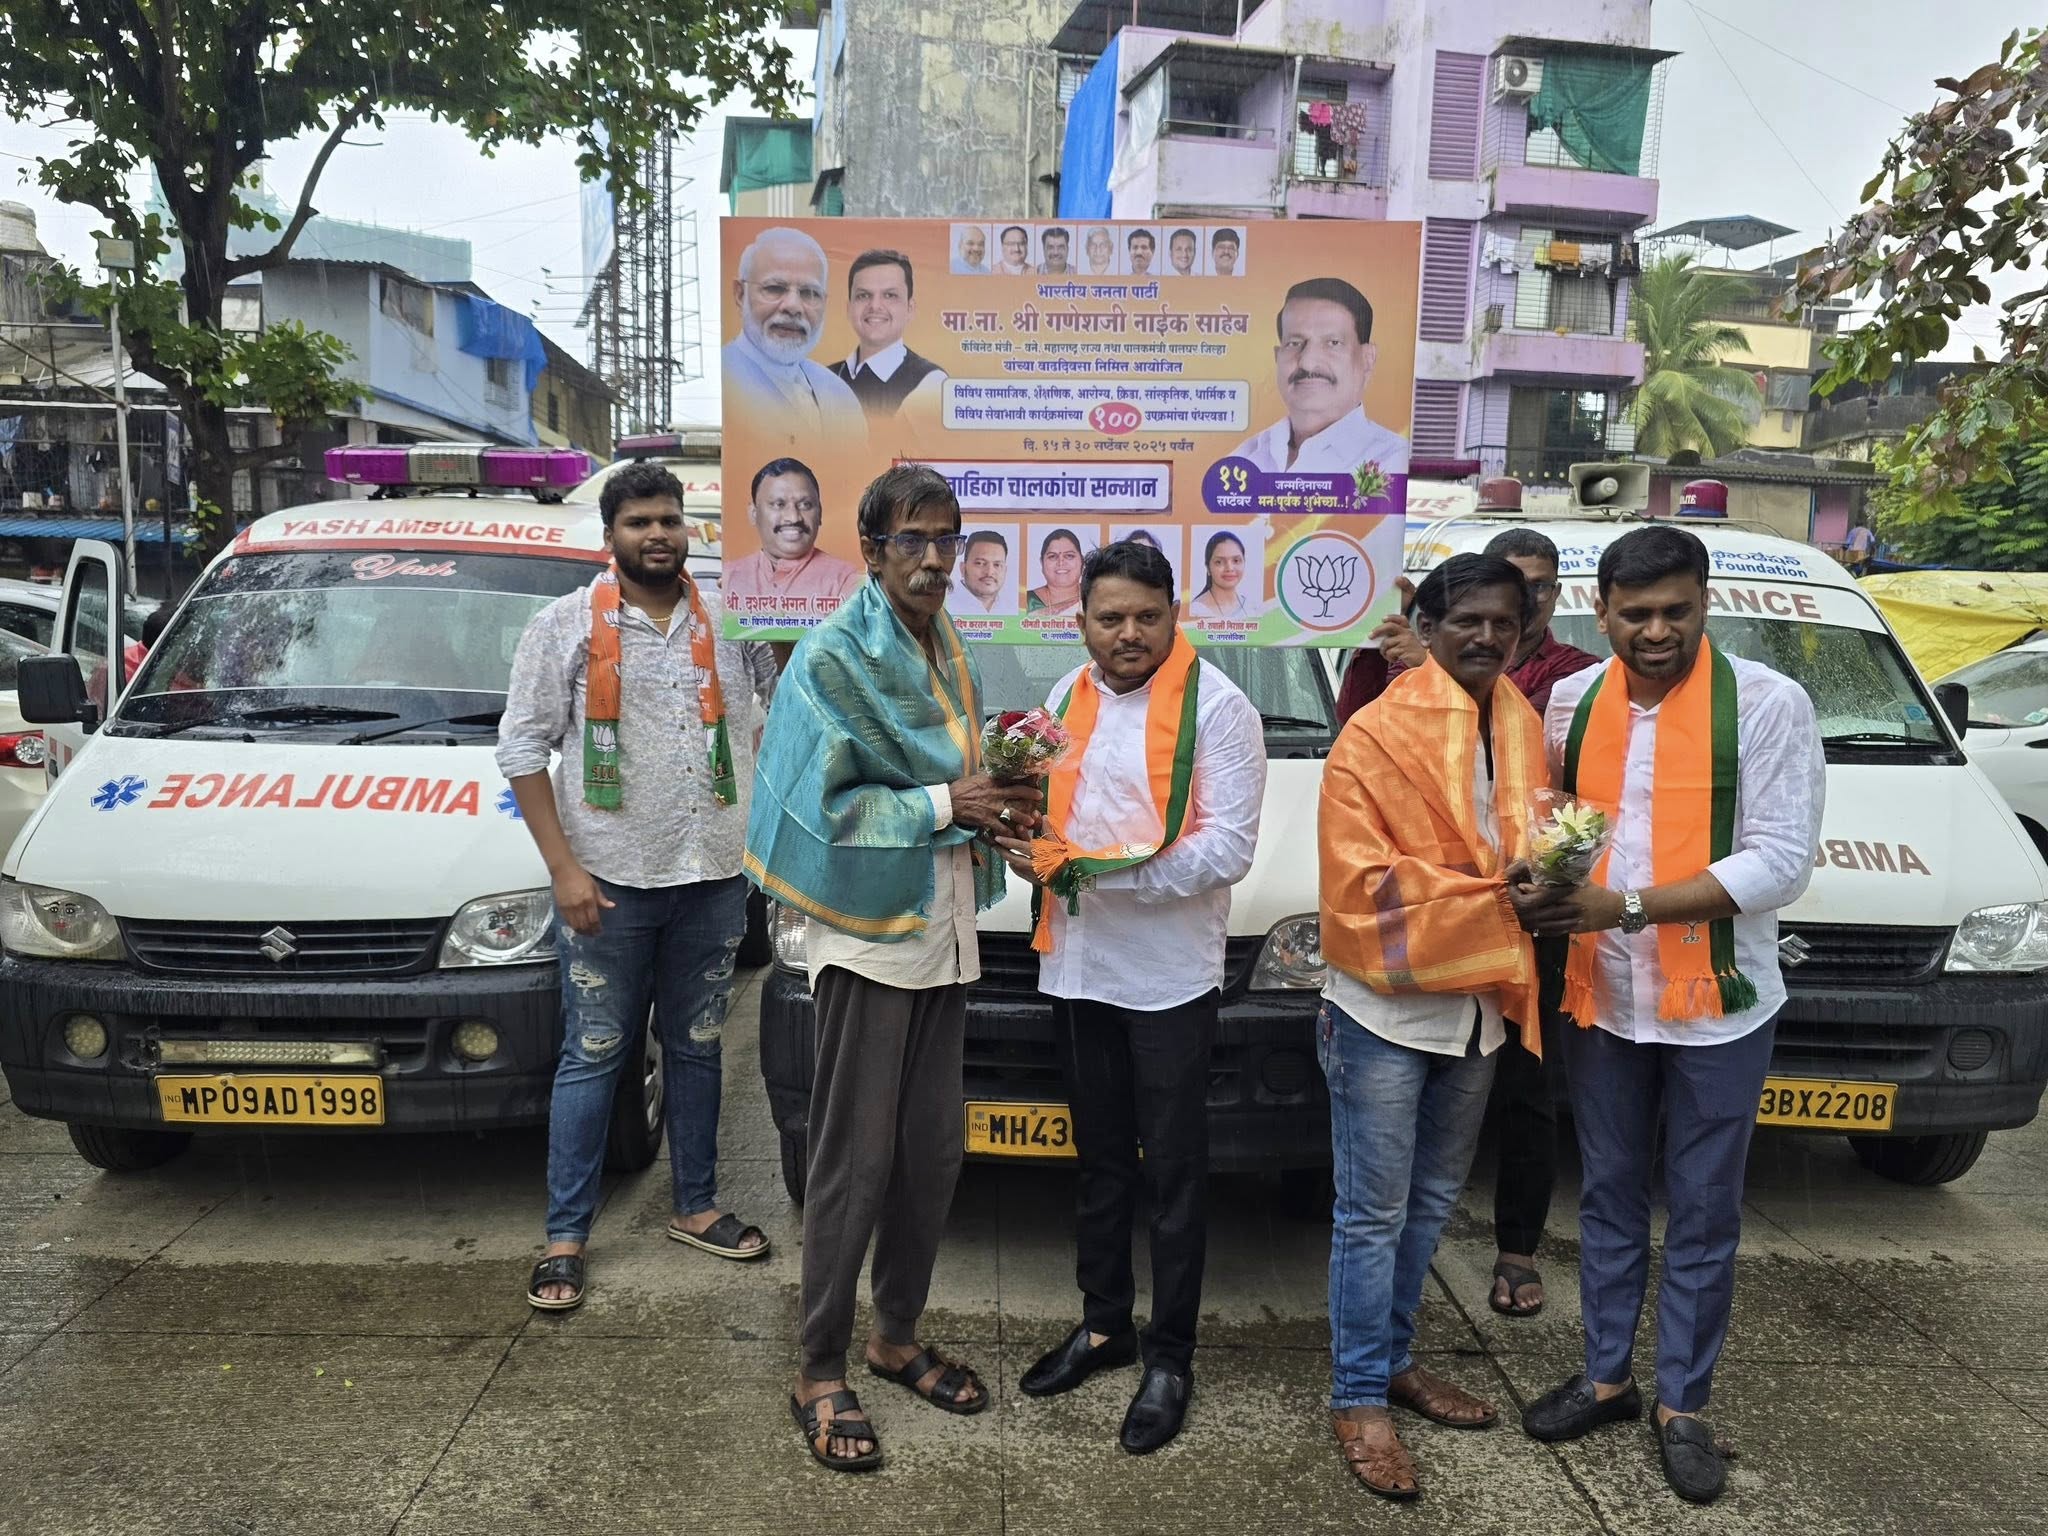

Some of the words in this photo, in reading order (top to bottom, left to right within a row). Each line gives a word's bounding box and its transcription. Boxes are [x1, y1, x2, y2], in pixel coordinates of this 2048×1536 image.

[1037, 281, 1088, 298] भारतीय
[1090, 285, 1128, 299] जनता
[1131, 281, 1159, 299] पार्टी
[942, 312, 1004, 332] मा.ना.
[1012, 303, 1040, 332] श्री
[1044, 303, 1127, 333] गणेशजी
[1133, 303, 1190, 337] नाईक
[1194, 305, 1249, 335] साहेब
[994, 339, 1013, 353] मंत्री
[1044, 342, 1078, 355] महाराष्ट्र
[1080, 342, 1101, 355] राज्य
[1103, 343, 1121, 354] तथा
[1123, 340, 1167, 354] पालकमंत्री
[1200, 341, 1227, 355] जिल्हा
[1003, 357, 1035, 372] यांच्या
[1037, 358, 1092, 374] वाढदिवसा
[1095, 358, 1130, 372] निमित्त
[1133, 358, 1184, 373] आयोजित
[954, 384, 983, 399] विविध
[984, 384, 1031, 400] सामाजिक,
[1077, 385, 1114, 400] आरोग्य,
[1195, 386, 1226, 400] धार्मिक
[1228, 389, 1236, 400] व
[954, 405, 983, 420] विविध
[985, 405, 1026, 420] सेवाभावी
[1028, 406, 1084, 421] कार्यक्रमांच्या
[1094, 406, 1138, 430] १००
[1144, 408, 1189, 421] उपक्रमांचा
[1191, 408, 1228, 422] पंधरवडा
[1023, 438, 1038, 452] दि.
[1042, 440, 1059, 452] १५
[1061, 438, 1071, 451] ते
[1074, 440, 1090, 453] ३०
[1093, 438, 1130, 452] सप्टेंबर
[1132, 440, 1167, 453] २०२५
[1007, 471, 1087, 498] चालकांचा
[1089, 477, 1159, 498] सन्मान
[1218, 465, 1248, 492] १५
[1274, 478, 1333, 493] जन्मदिनाच्या
[1216, 492, 1252, 508] सप्टेंबर
[1257, 492, 1301, 512] मनःपूर्वक
[282, 519, 372, 536] YASH
[374, 519, 566, 543] AMBULANCE
[350, 553, 458, 580] Yash
[1714, 560, 1809, 578] Foundation
[727, 592, 742, 611] श्री.
[745, 596, 777, 613] दशरथ
[780, 596, 808, 612] भगत
[739, 617, 750, 627] मा.
[751, 615, 774, 627] विरोधी
[1216, 632, 1246, 641] नगरसेविका
[180, 1086, 378, 1116] MP09AD1998
[971, 1122, 989, 1132] IND
